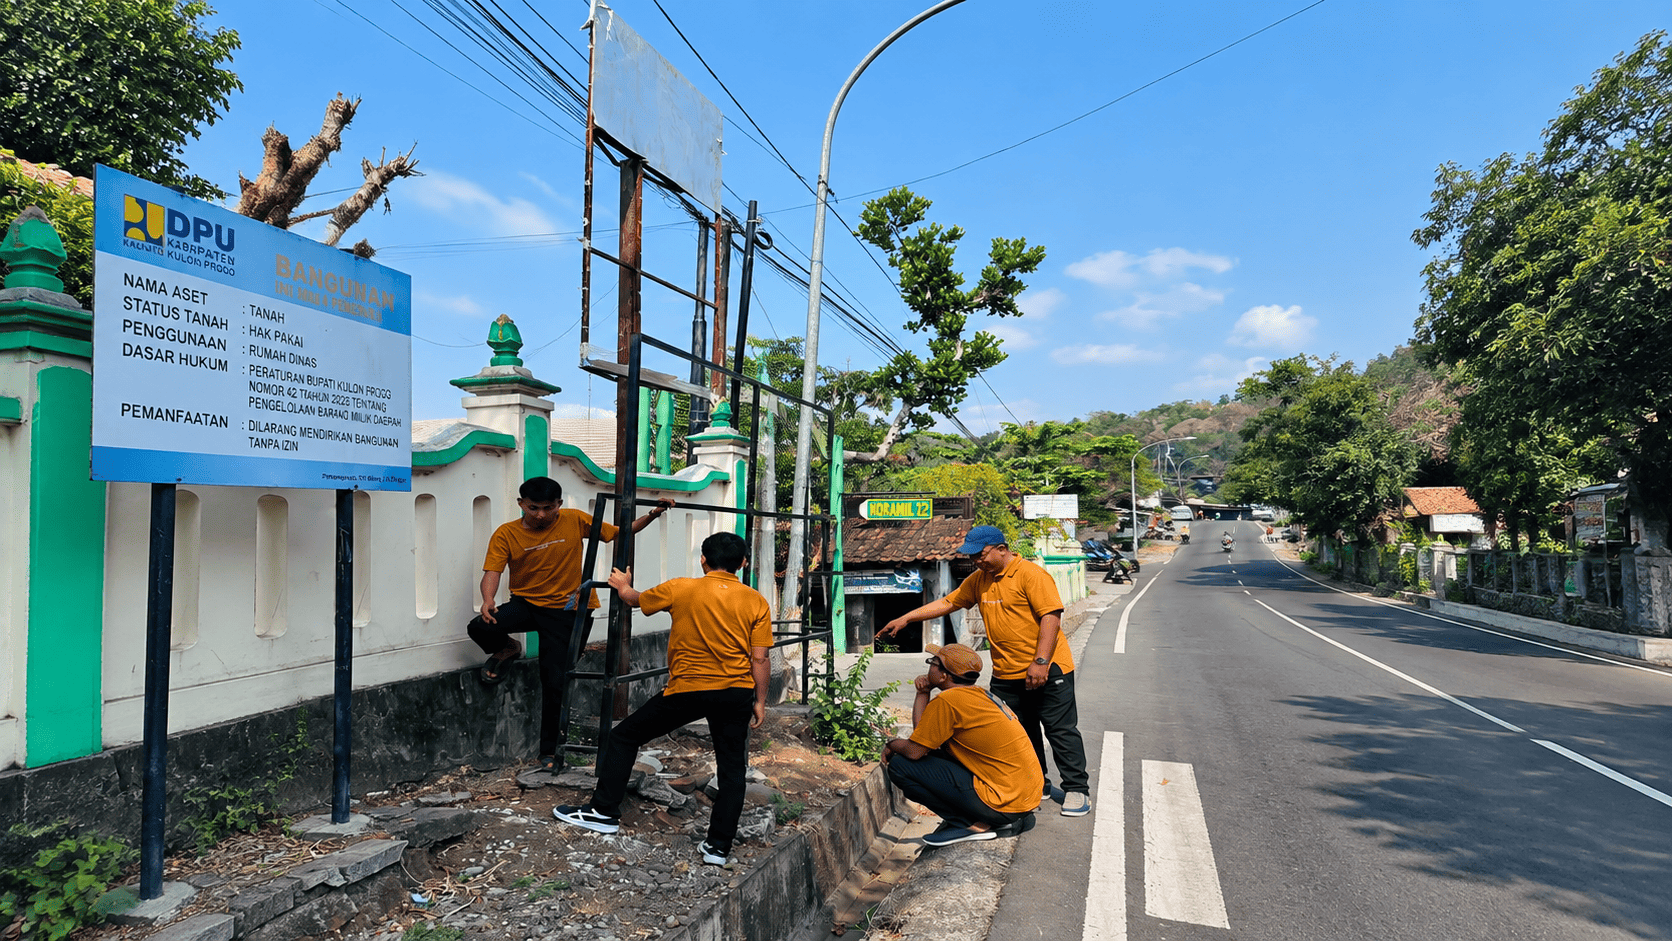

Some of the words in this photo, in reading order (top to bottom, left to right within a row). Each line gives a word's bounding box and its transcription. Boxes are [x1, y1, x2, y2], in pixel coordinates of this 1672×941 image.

[167, 208, 235, 252] DPU
[124, 273, 168, 296] NAMA
[172, 286, 208, 305] ASET
[249, 304, 285, 324] TANAH
[276, 254, 394, 312] BANGUNAN
[122, 319, 227, 352] PENGGUNAAN
[249, 344, 286, 363] RUMAH
[289, 353, 317, 368] DINAS
[123, 296, 180, 321] STATUS
[184, 309, 229, 331] TANAH
[249, 324, 271, 340] HAK
[274, 331, 304, 348] PAKAI
[122, 343, 175, 364] DASAR
[179, 352, 228, 372] HUKUM
[249, 364, 305, 384] PERATURAN
[306, 375, 336, 390] BUPATI
[337, 381, 364, 395] KULON
[249, 381, 285, 397] NOMOR
[352, 397, 387, 413] TENTANG
[121, 403, 228, 428] PEMANFAATAN
[248, 419, 297, 436] DILARANG
[299, 426, 353, 443] MENDIRIKAN
[248, 437, 280, 450] TANPA
[281, 440, 299, 452] IZIN
